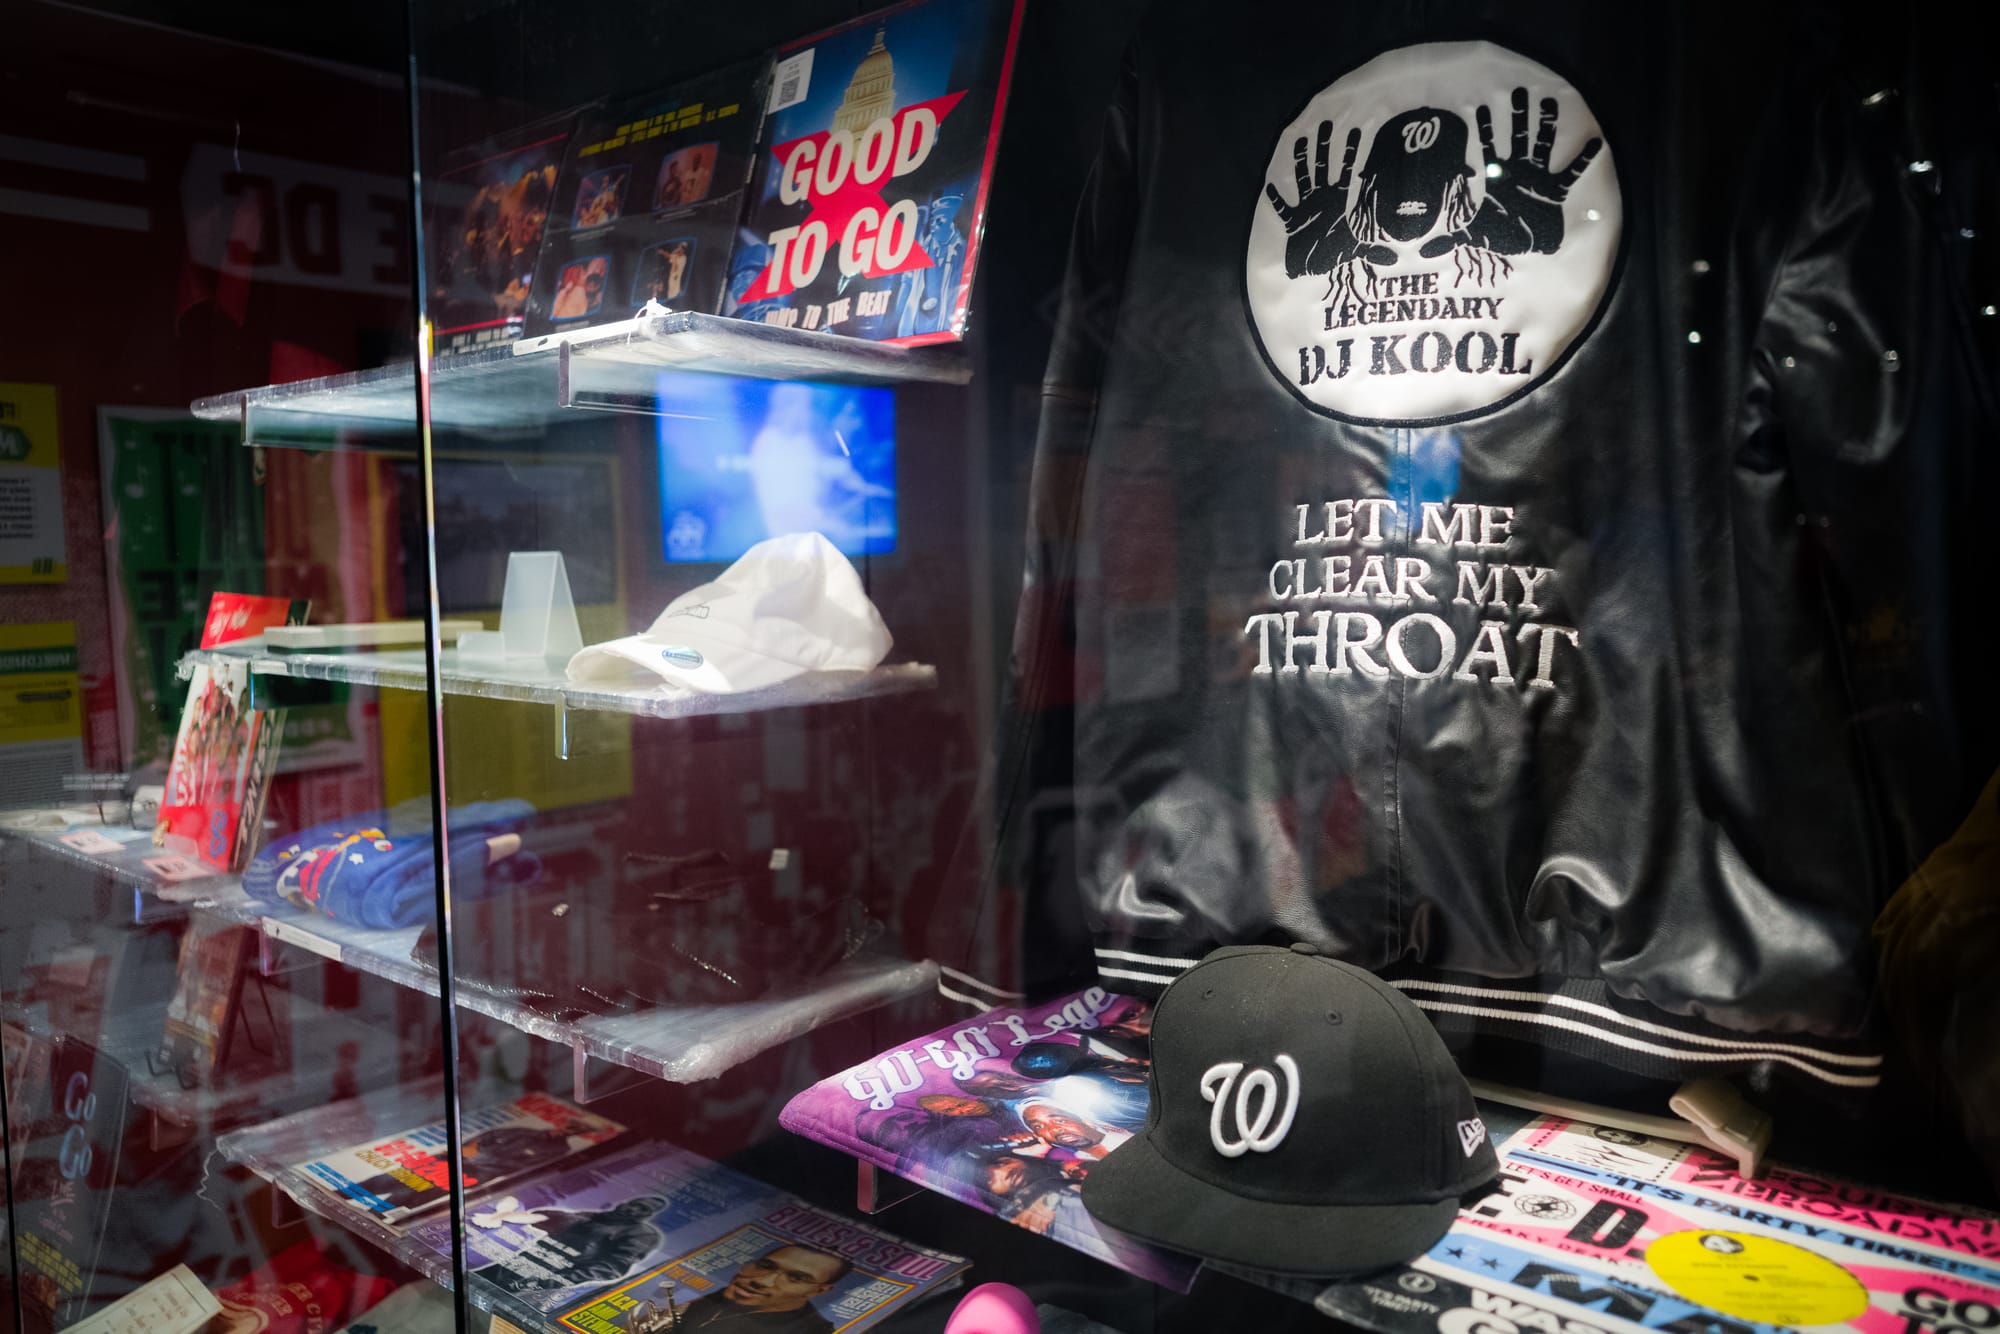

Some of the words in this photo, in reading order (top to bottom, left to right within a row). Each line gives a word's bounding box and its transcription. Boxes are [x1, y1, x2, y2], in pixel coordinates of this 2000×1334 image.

[780, 107, 937, 207] GOOD
[765, 223, 829, 295] TO
[838, 199, 918, 275] GO
[826, 297, 850, 326] THE
[855, 290, 892, 317] BEAT
[1380, 272, 1439, 298] THE
[1323, 297, 1504, 331] LEGENDARY
[1298, 338, 1355, 386] DJ
[1368, 331, 1533, 377] KOOL
[1294, 498, 1398, 546] LET
[1417, 501, 1515, 548] ME
[1269, 555, 1438, 601] CLEAR
[1453, 560, 1556, 610] MY
[1244, 610, 1580, 689] THROAT
[1200, 1053, 1300, 1158] W
[1506, 1161, 1551, 1180] LET'S
[1554, 1174, 1585, 1189] GET
[1588, 1184, 1643, 1204] SMALL
[765, 1204, 850, 1248] BLUES
[837, 1235, 879, 1257] &
[862, 1245, 951, 1281] SOUL
[1693, 1196, 1829, 1238] PARTY
